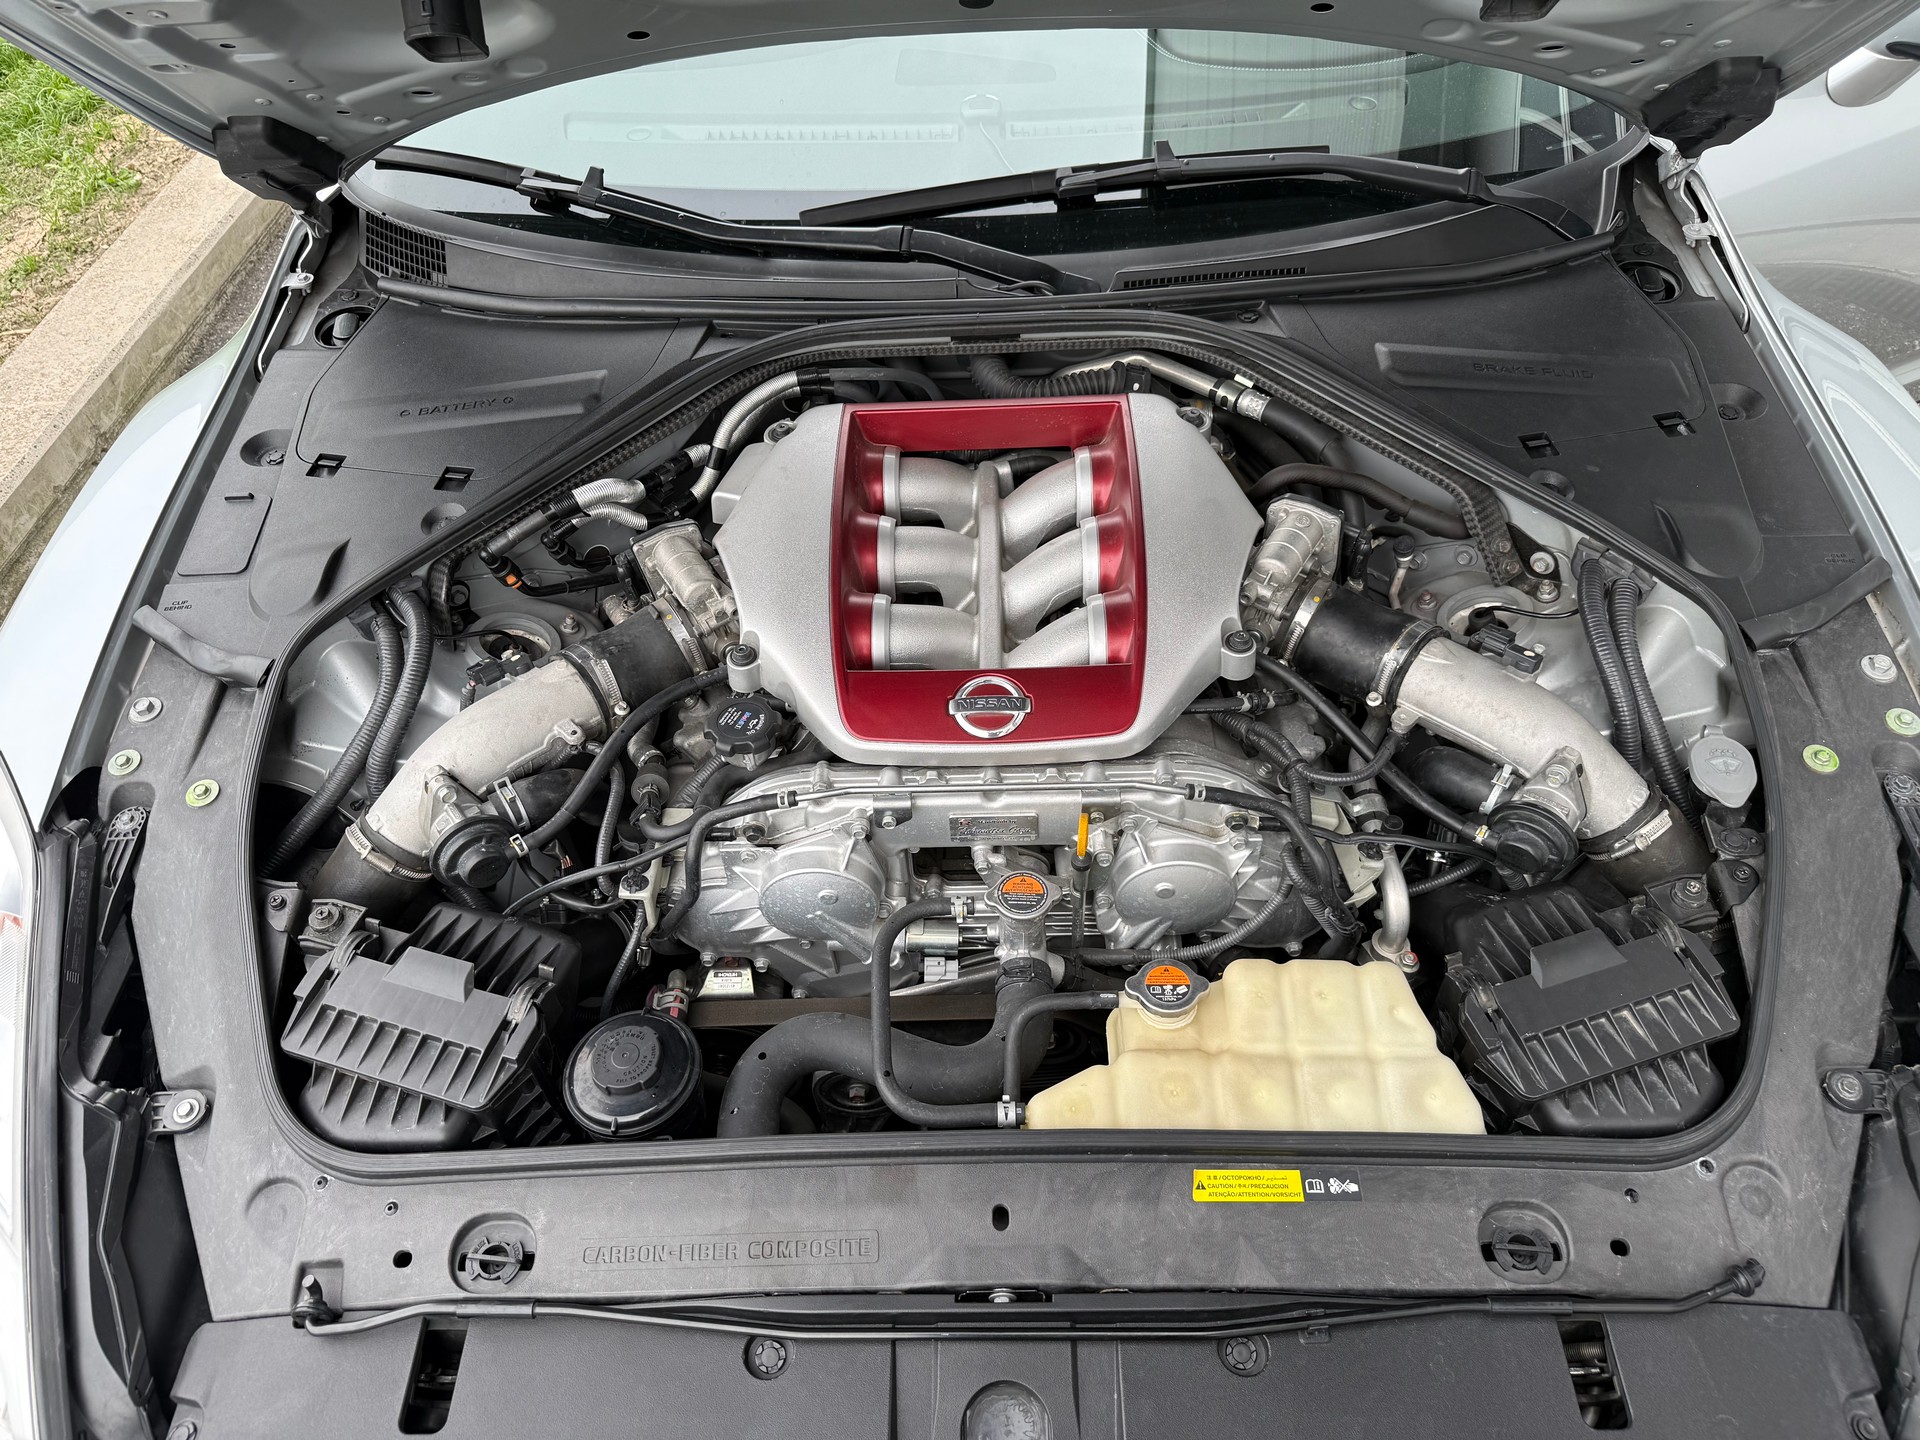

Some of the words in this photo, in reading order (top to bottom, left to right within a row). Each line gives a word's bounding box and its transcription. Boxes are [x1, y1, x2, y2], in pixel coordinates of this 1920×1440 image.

[1473, 363, 1536, 375] BRAKE
[1542, 367, 1593, 379] FLUID
[418, 398, 496, 416] BATTERY
[958, 698, 1022, 710] NISSAN
[623, 1055, 648, 1077] CAUTION
[582, 1242, 738, 1264] CARBON-FIBER
[748, 1237, 871, 1259] COMPOSITE
